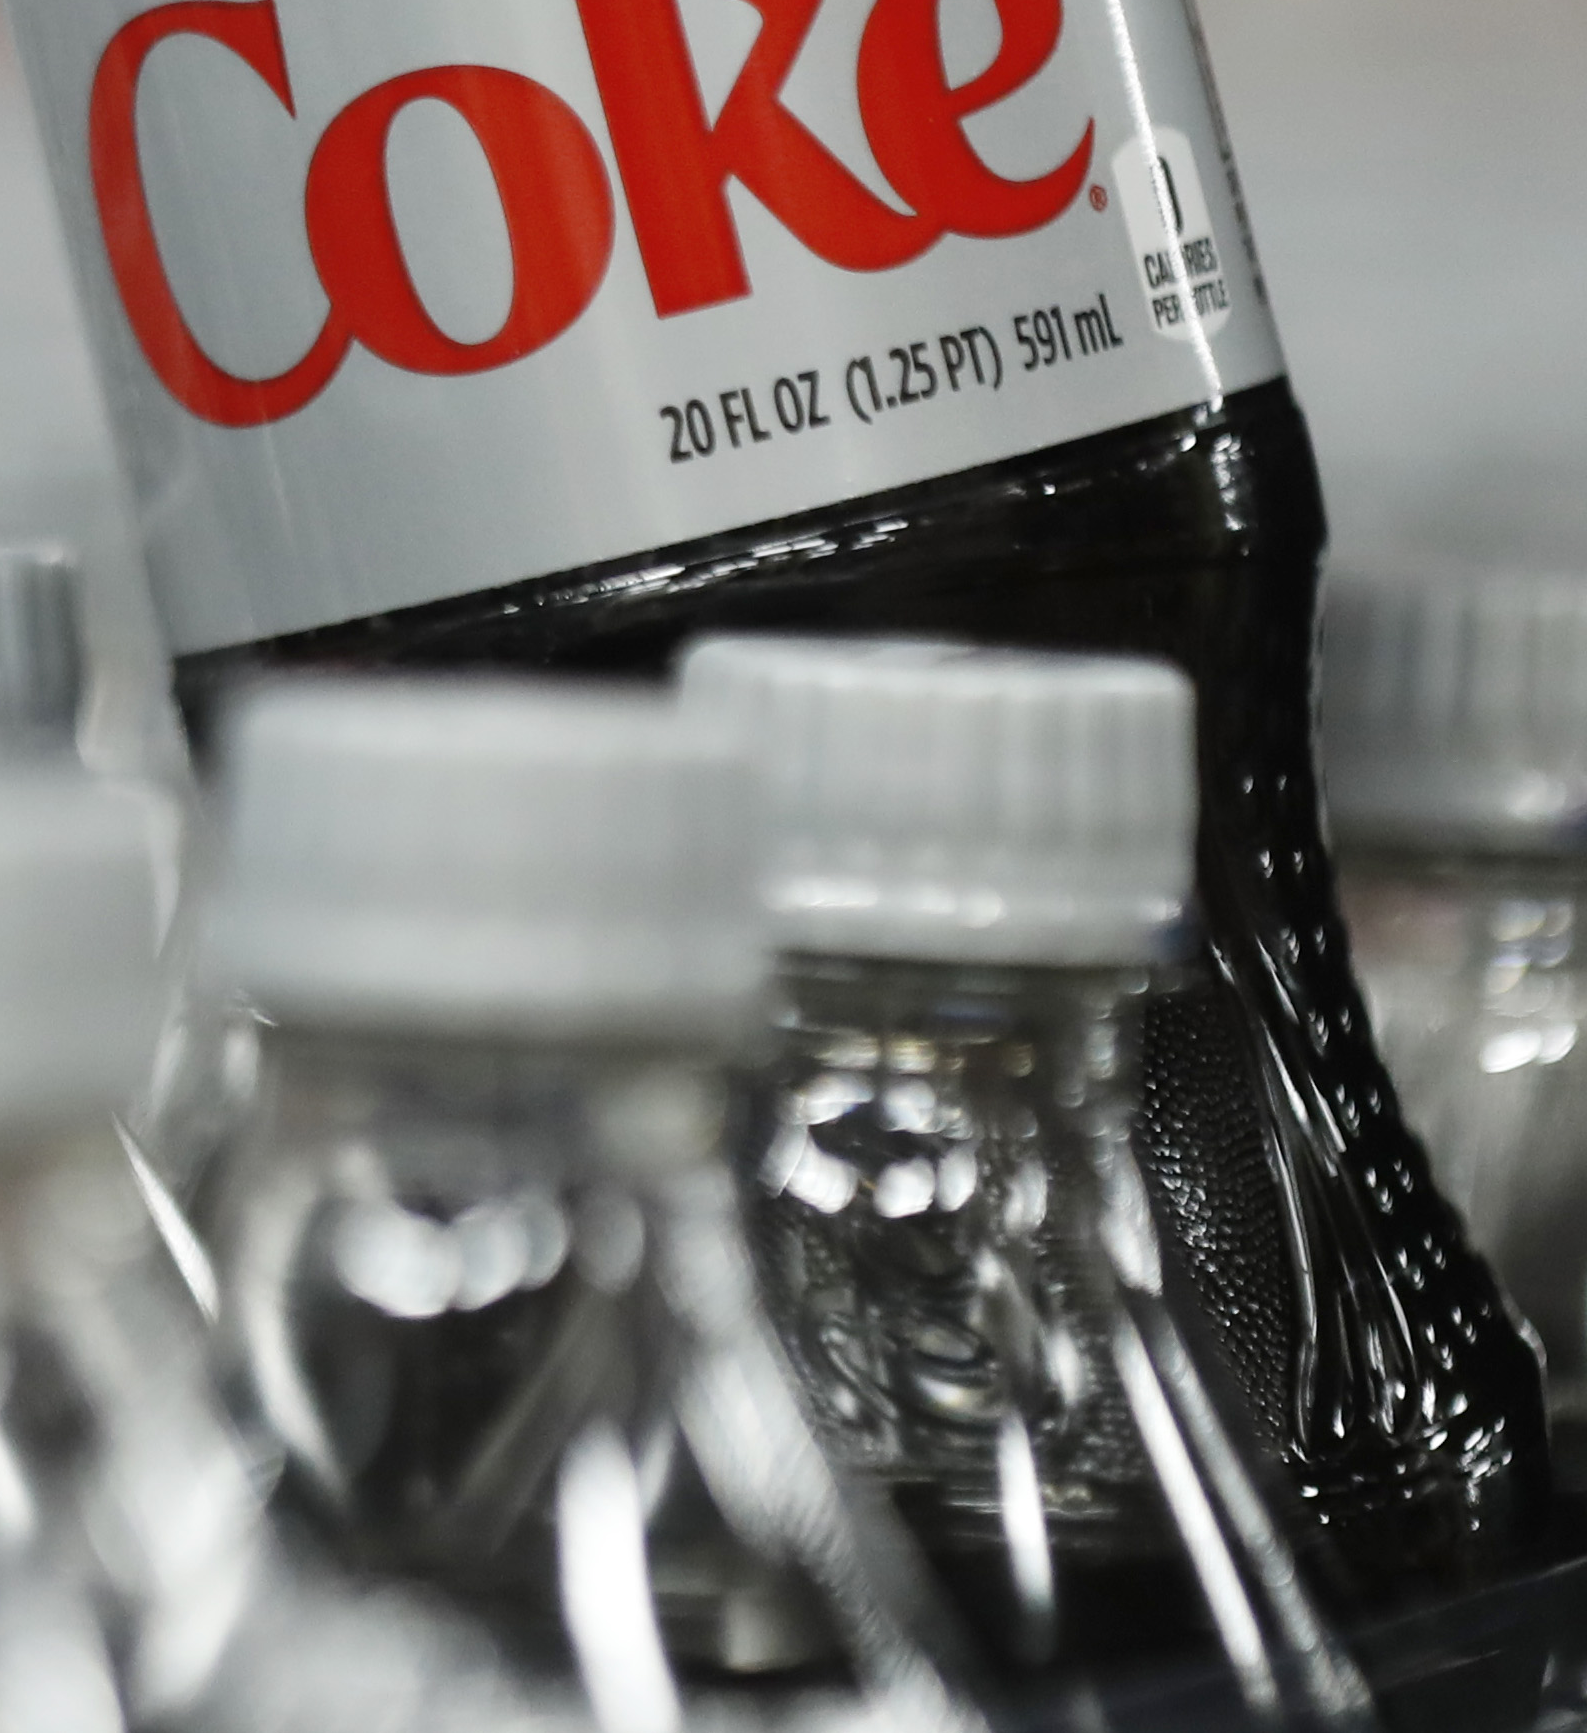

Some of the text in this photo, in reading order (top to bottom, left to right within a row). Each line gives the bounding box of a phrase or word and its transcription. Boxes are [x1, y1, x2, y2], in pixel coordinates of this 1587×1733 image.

[659, 292, 1125, 464] 20 FL OZ (1.25 PT) 591 mL
